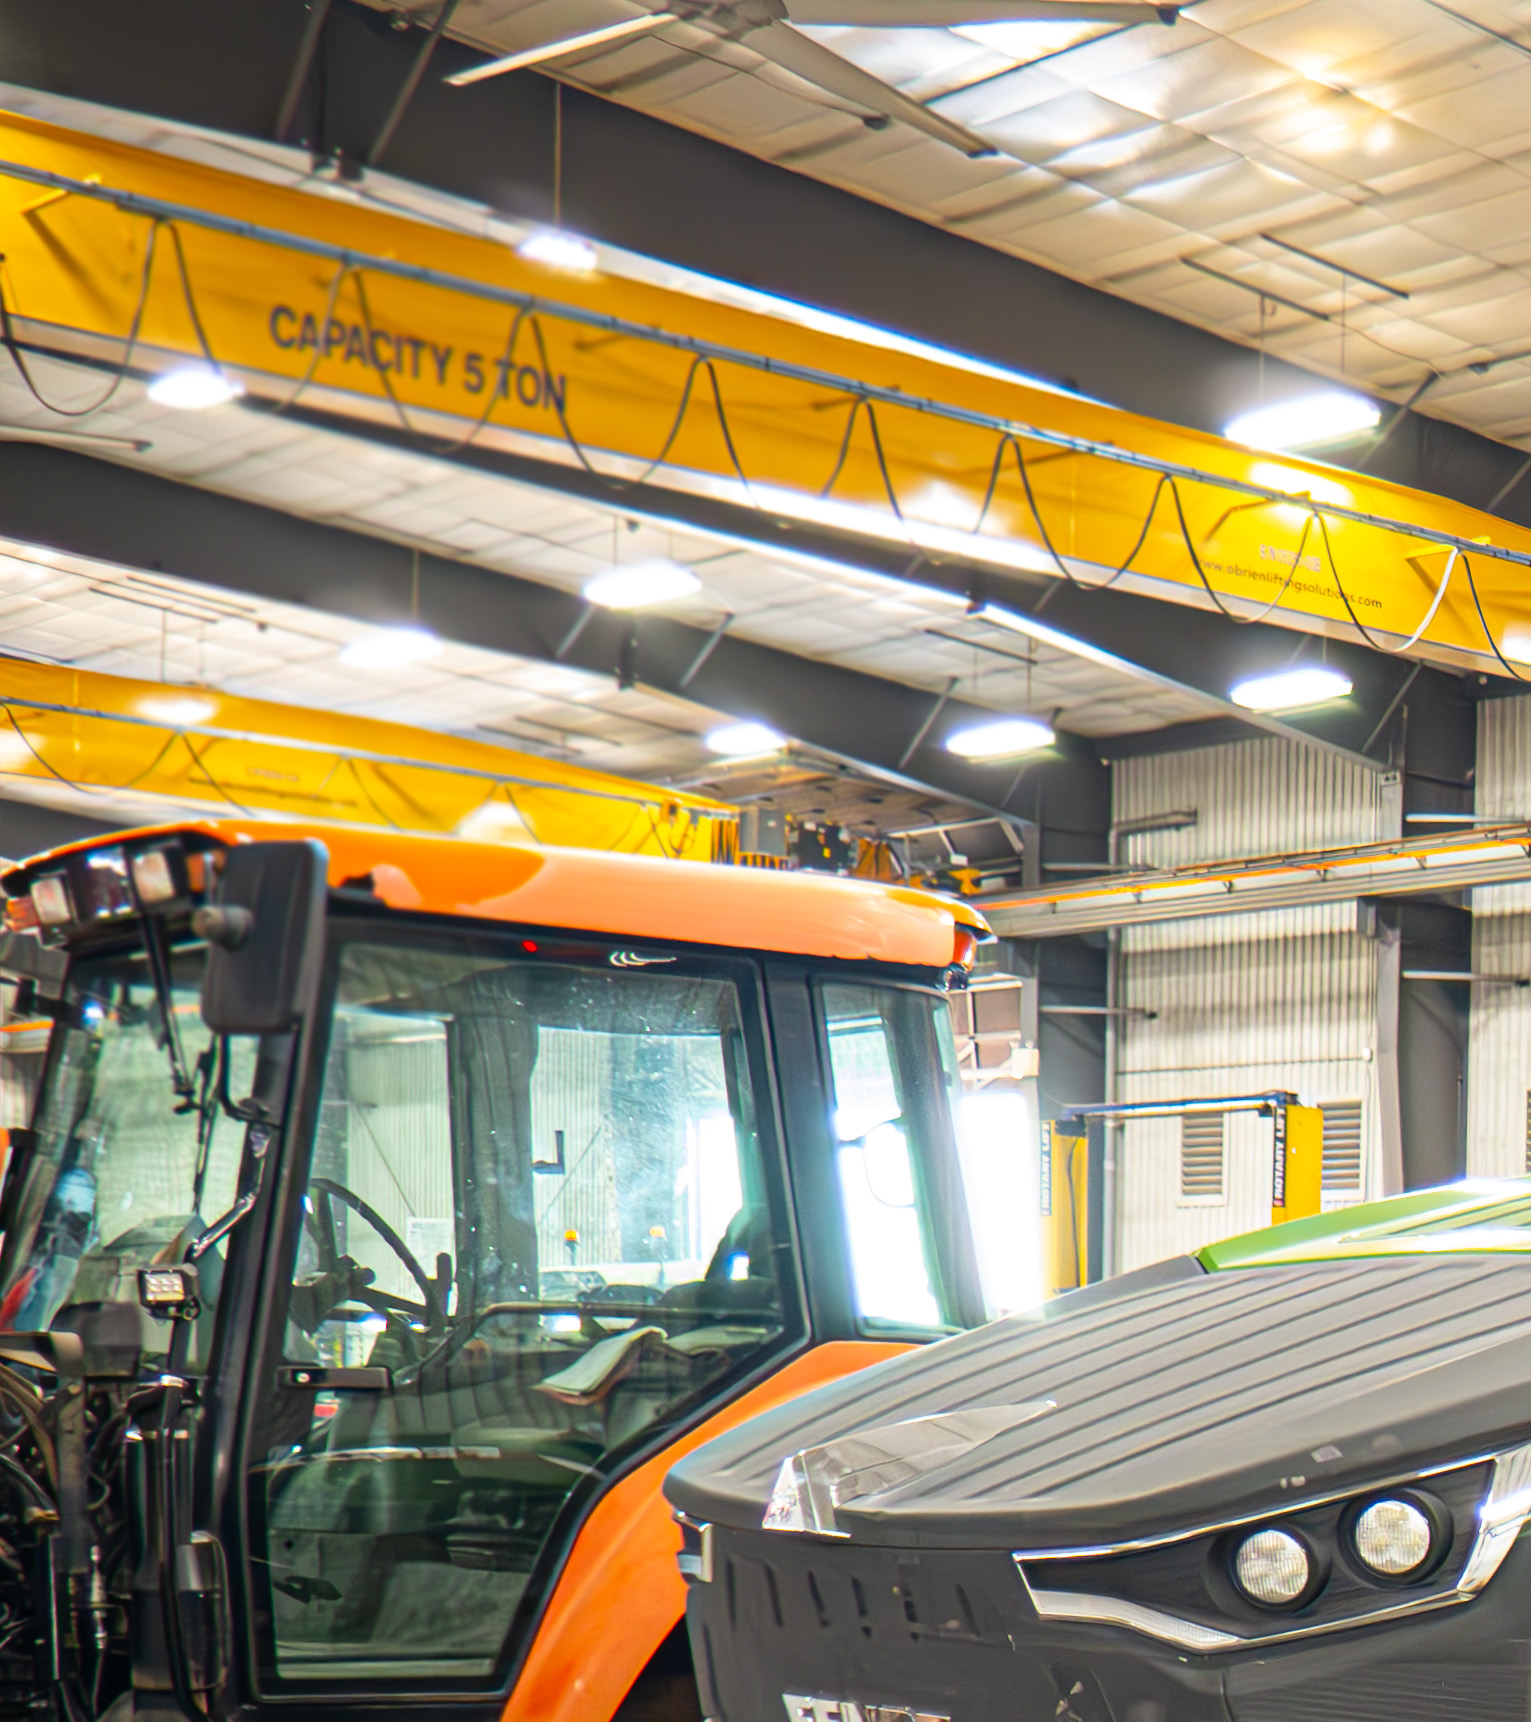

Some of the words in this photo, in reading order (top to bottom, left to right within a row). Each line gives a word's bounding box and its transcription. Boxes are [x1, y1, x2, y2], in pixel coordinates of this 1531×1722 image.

[268, 304, 452, 385] CAPACITY
[463, 352, 485, 394] 5
[494, 358, 567, 413] TON
